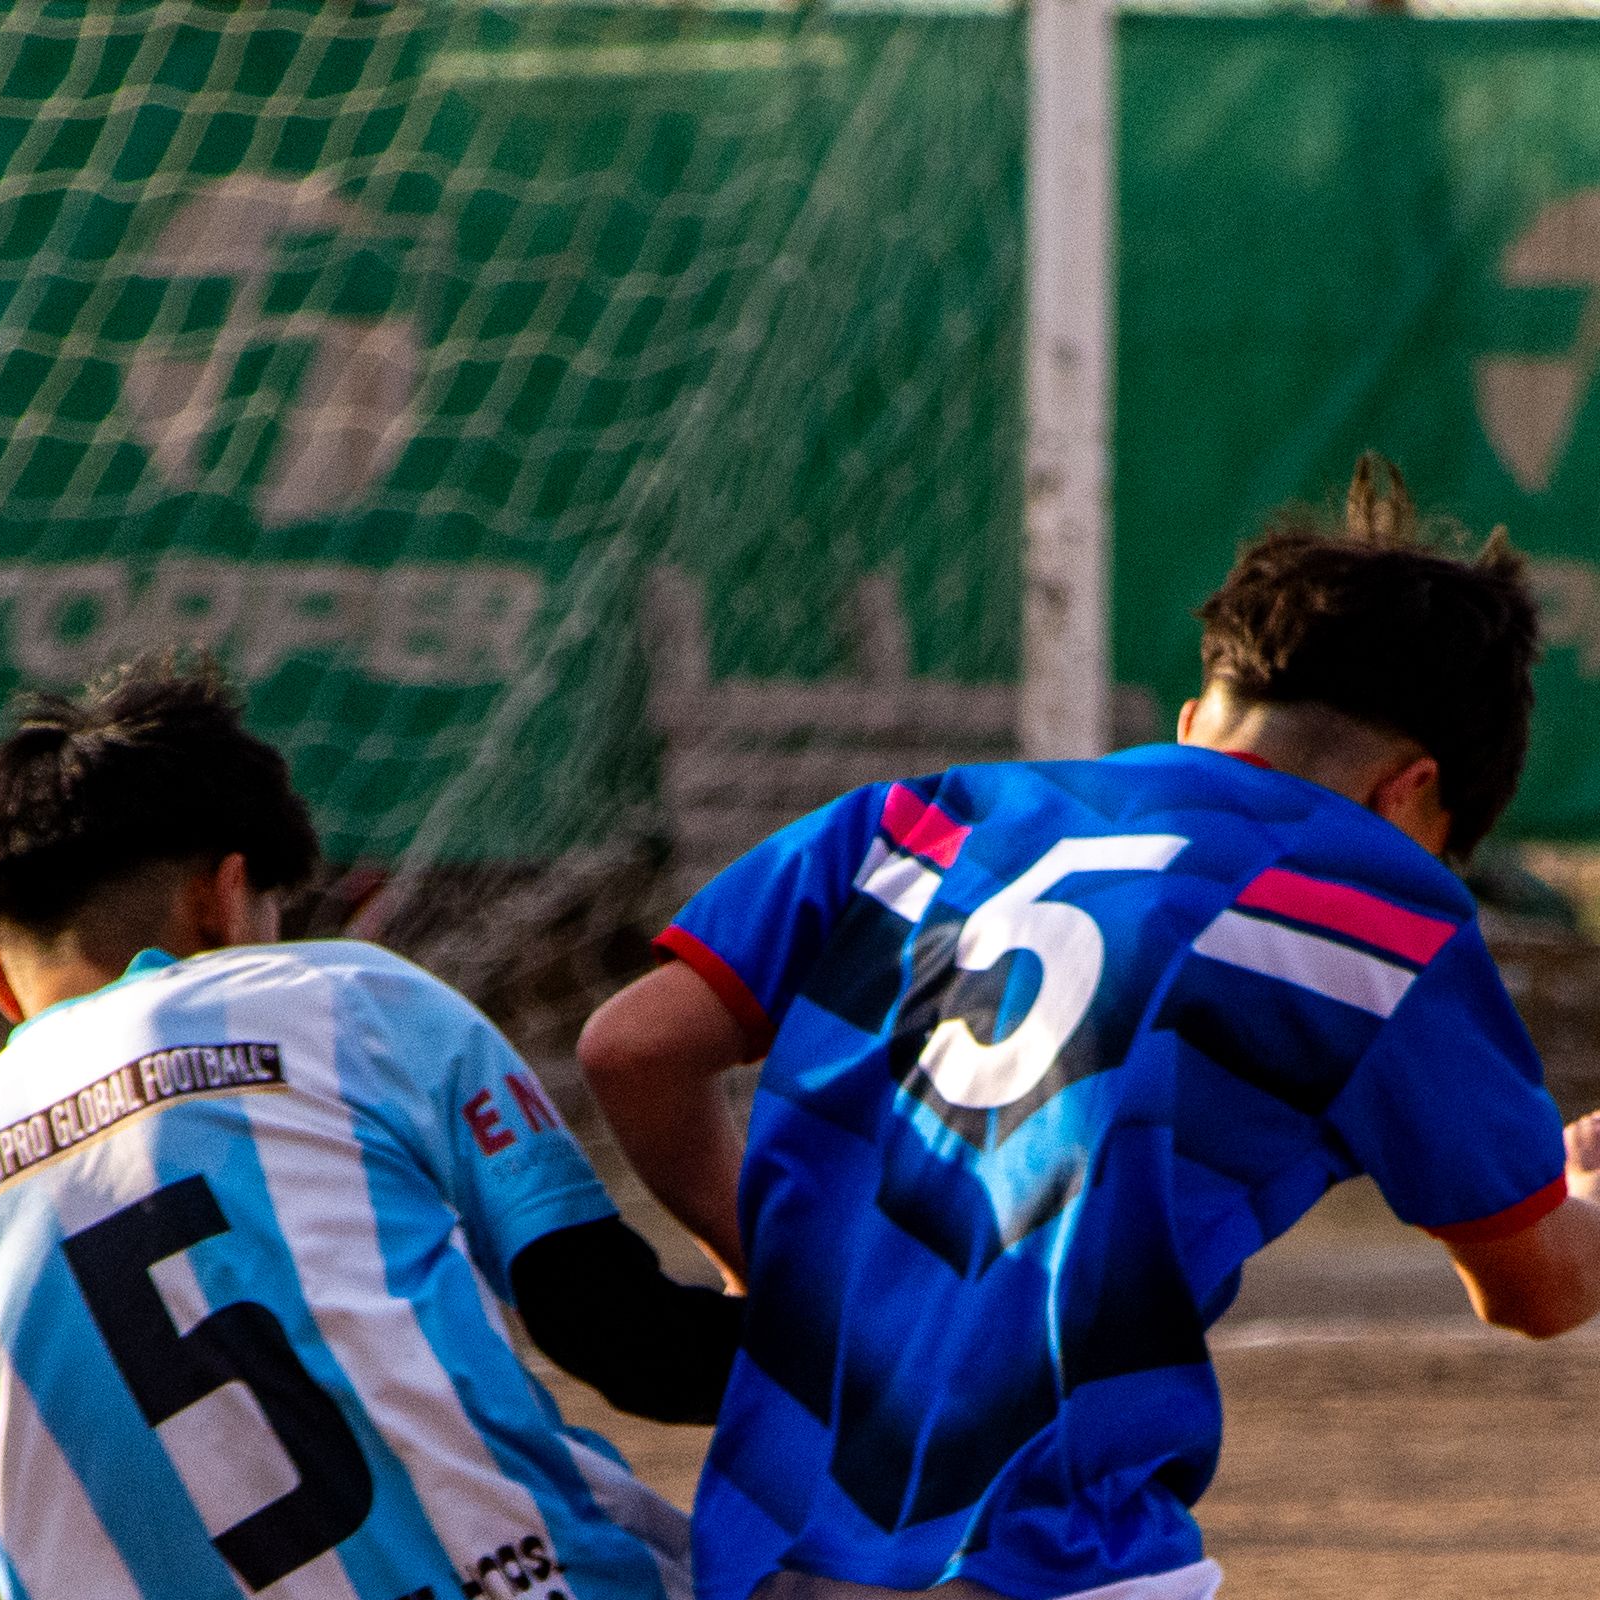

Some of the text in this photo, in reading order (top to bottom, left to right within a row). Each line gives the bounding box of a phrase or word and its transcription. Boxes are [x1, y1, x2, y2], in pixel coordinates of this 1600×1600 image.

[51, 1067, 144, 1147] GLOBAL
[918, 834, 1191, 1109] 5
[61, 1173, 375, 1594] 5
